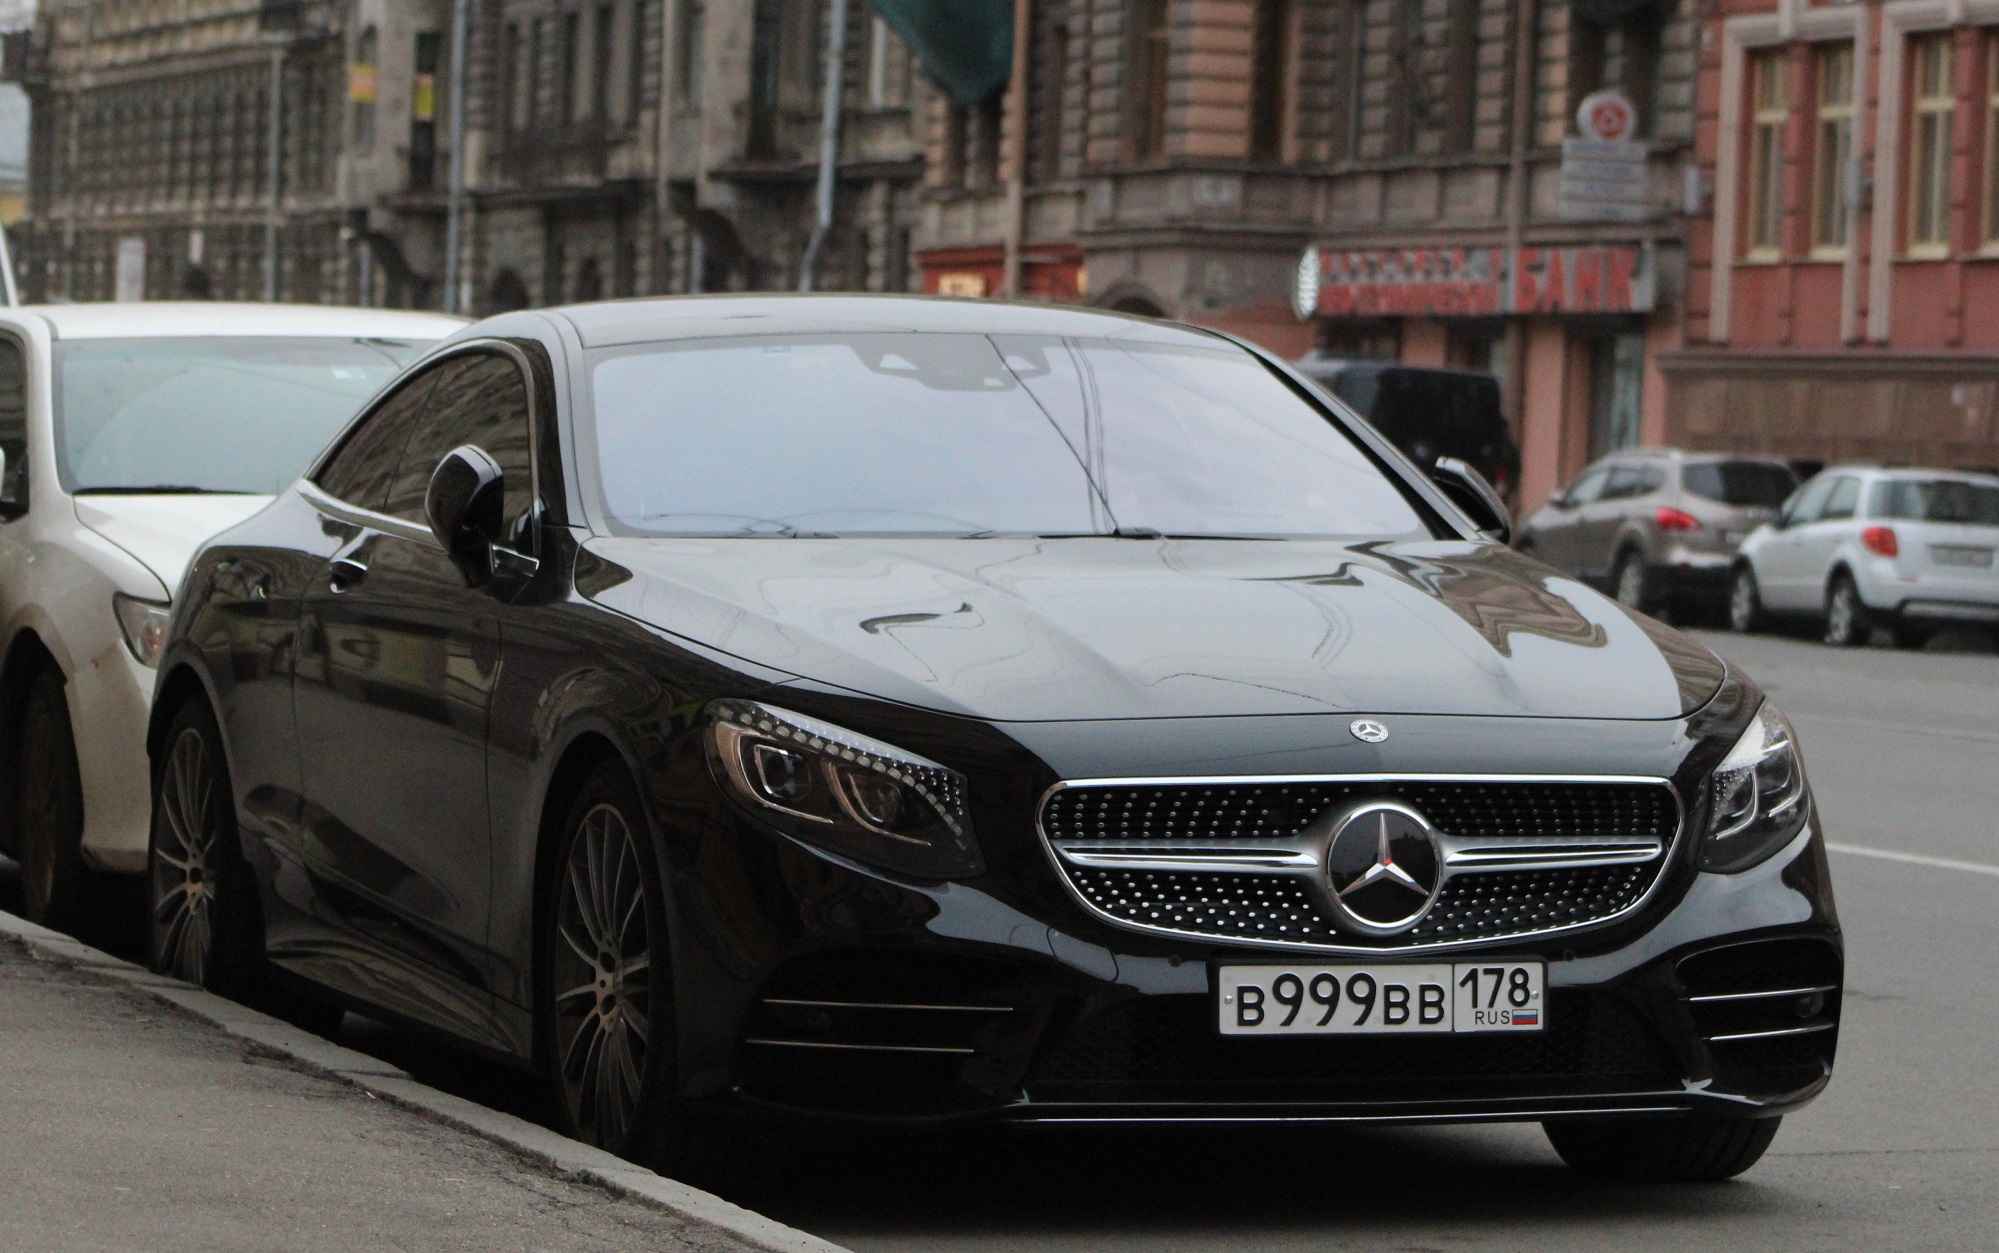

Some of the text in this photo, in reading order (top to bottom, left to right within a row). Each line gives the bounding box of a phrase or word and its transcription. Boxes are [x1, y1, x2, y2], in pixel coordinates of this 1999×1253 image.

[1515, 247, 1636, 312] БАНК
[1458, 967, 1531, 1009] 178
[1474, 1010, 1511, 1026] RUS
